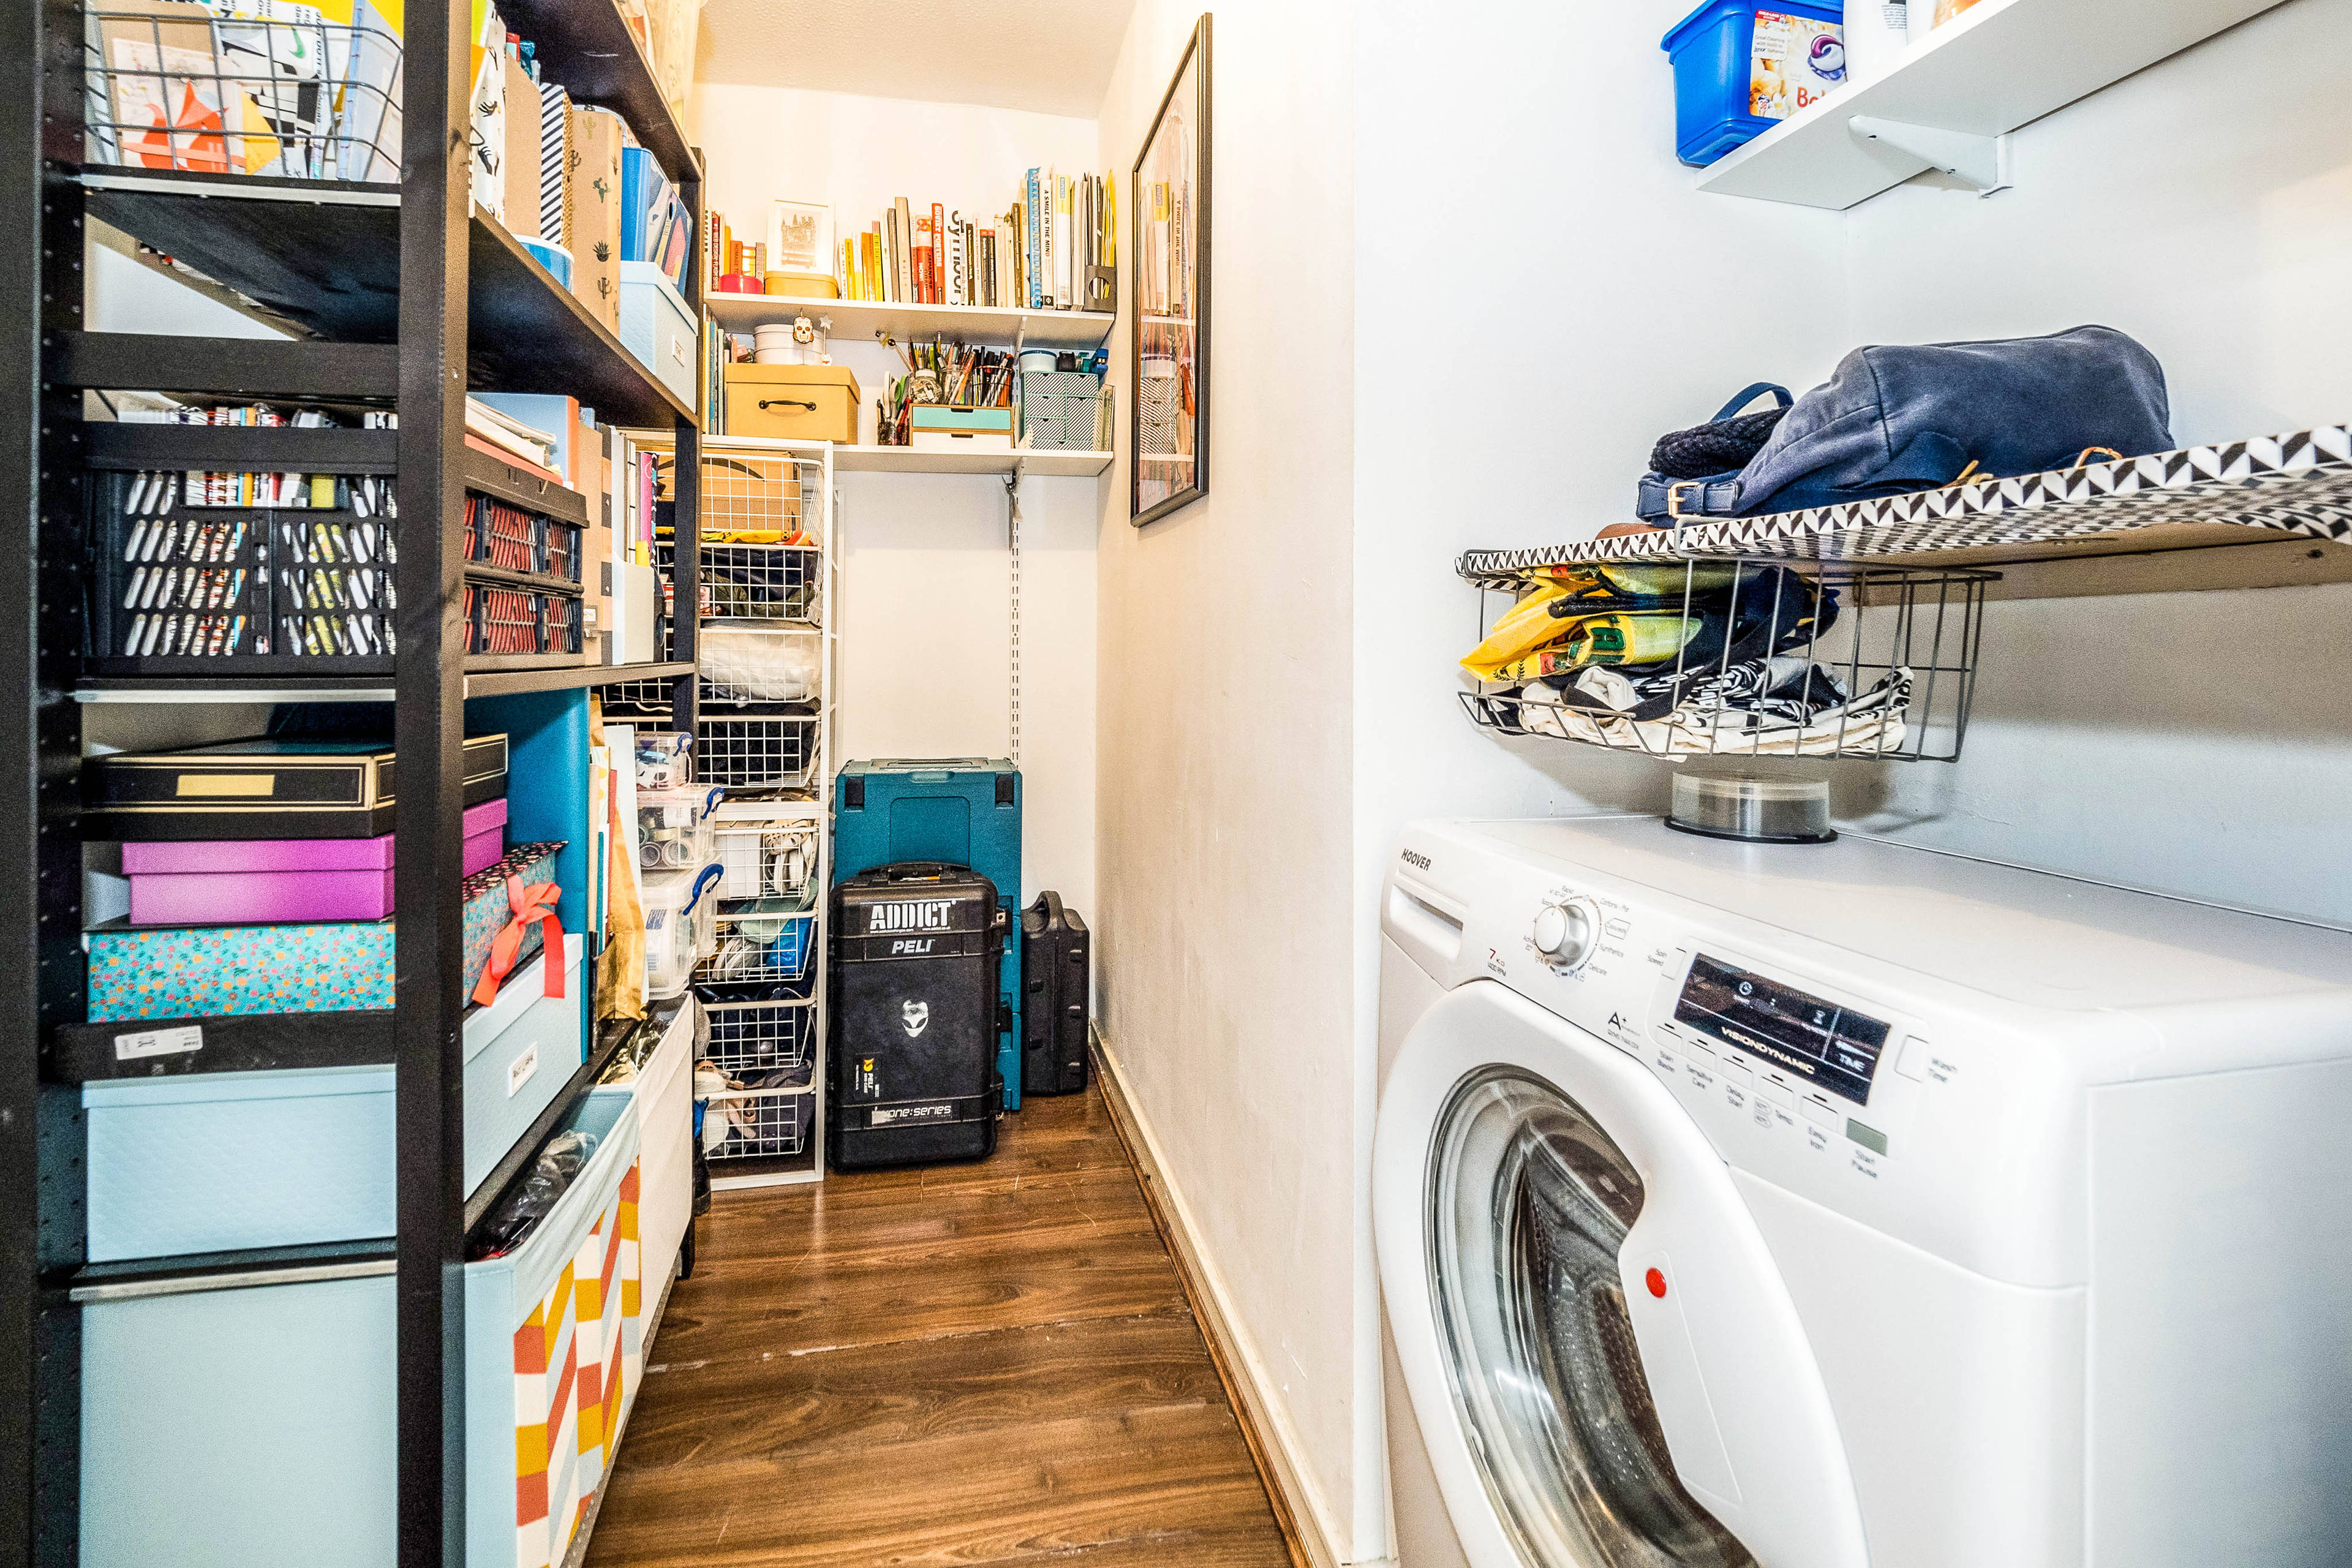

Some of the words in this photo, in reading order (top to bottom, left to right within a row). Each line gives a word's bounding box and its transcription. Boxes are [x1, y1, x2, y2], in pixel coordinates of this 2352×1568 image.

[1401, 848, 1431, 872] HOOVER
[870, 902, 951, 930] ADDICT
[892, 939, 932, 954] PELI
[1490, 948, 1496, 959] 7
[1721, 1025, 1816, 1076] VISIONDYNAMIC
[1838, 1052, 1866, 1072] TIME
[1686, 1063, 1714, 1084] Sensitive
